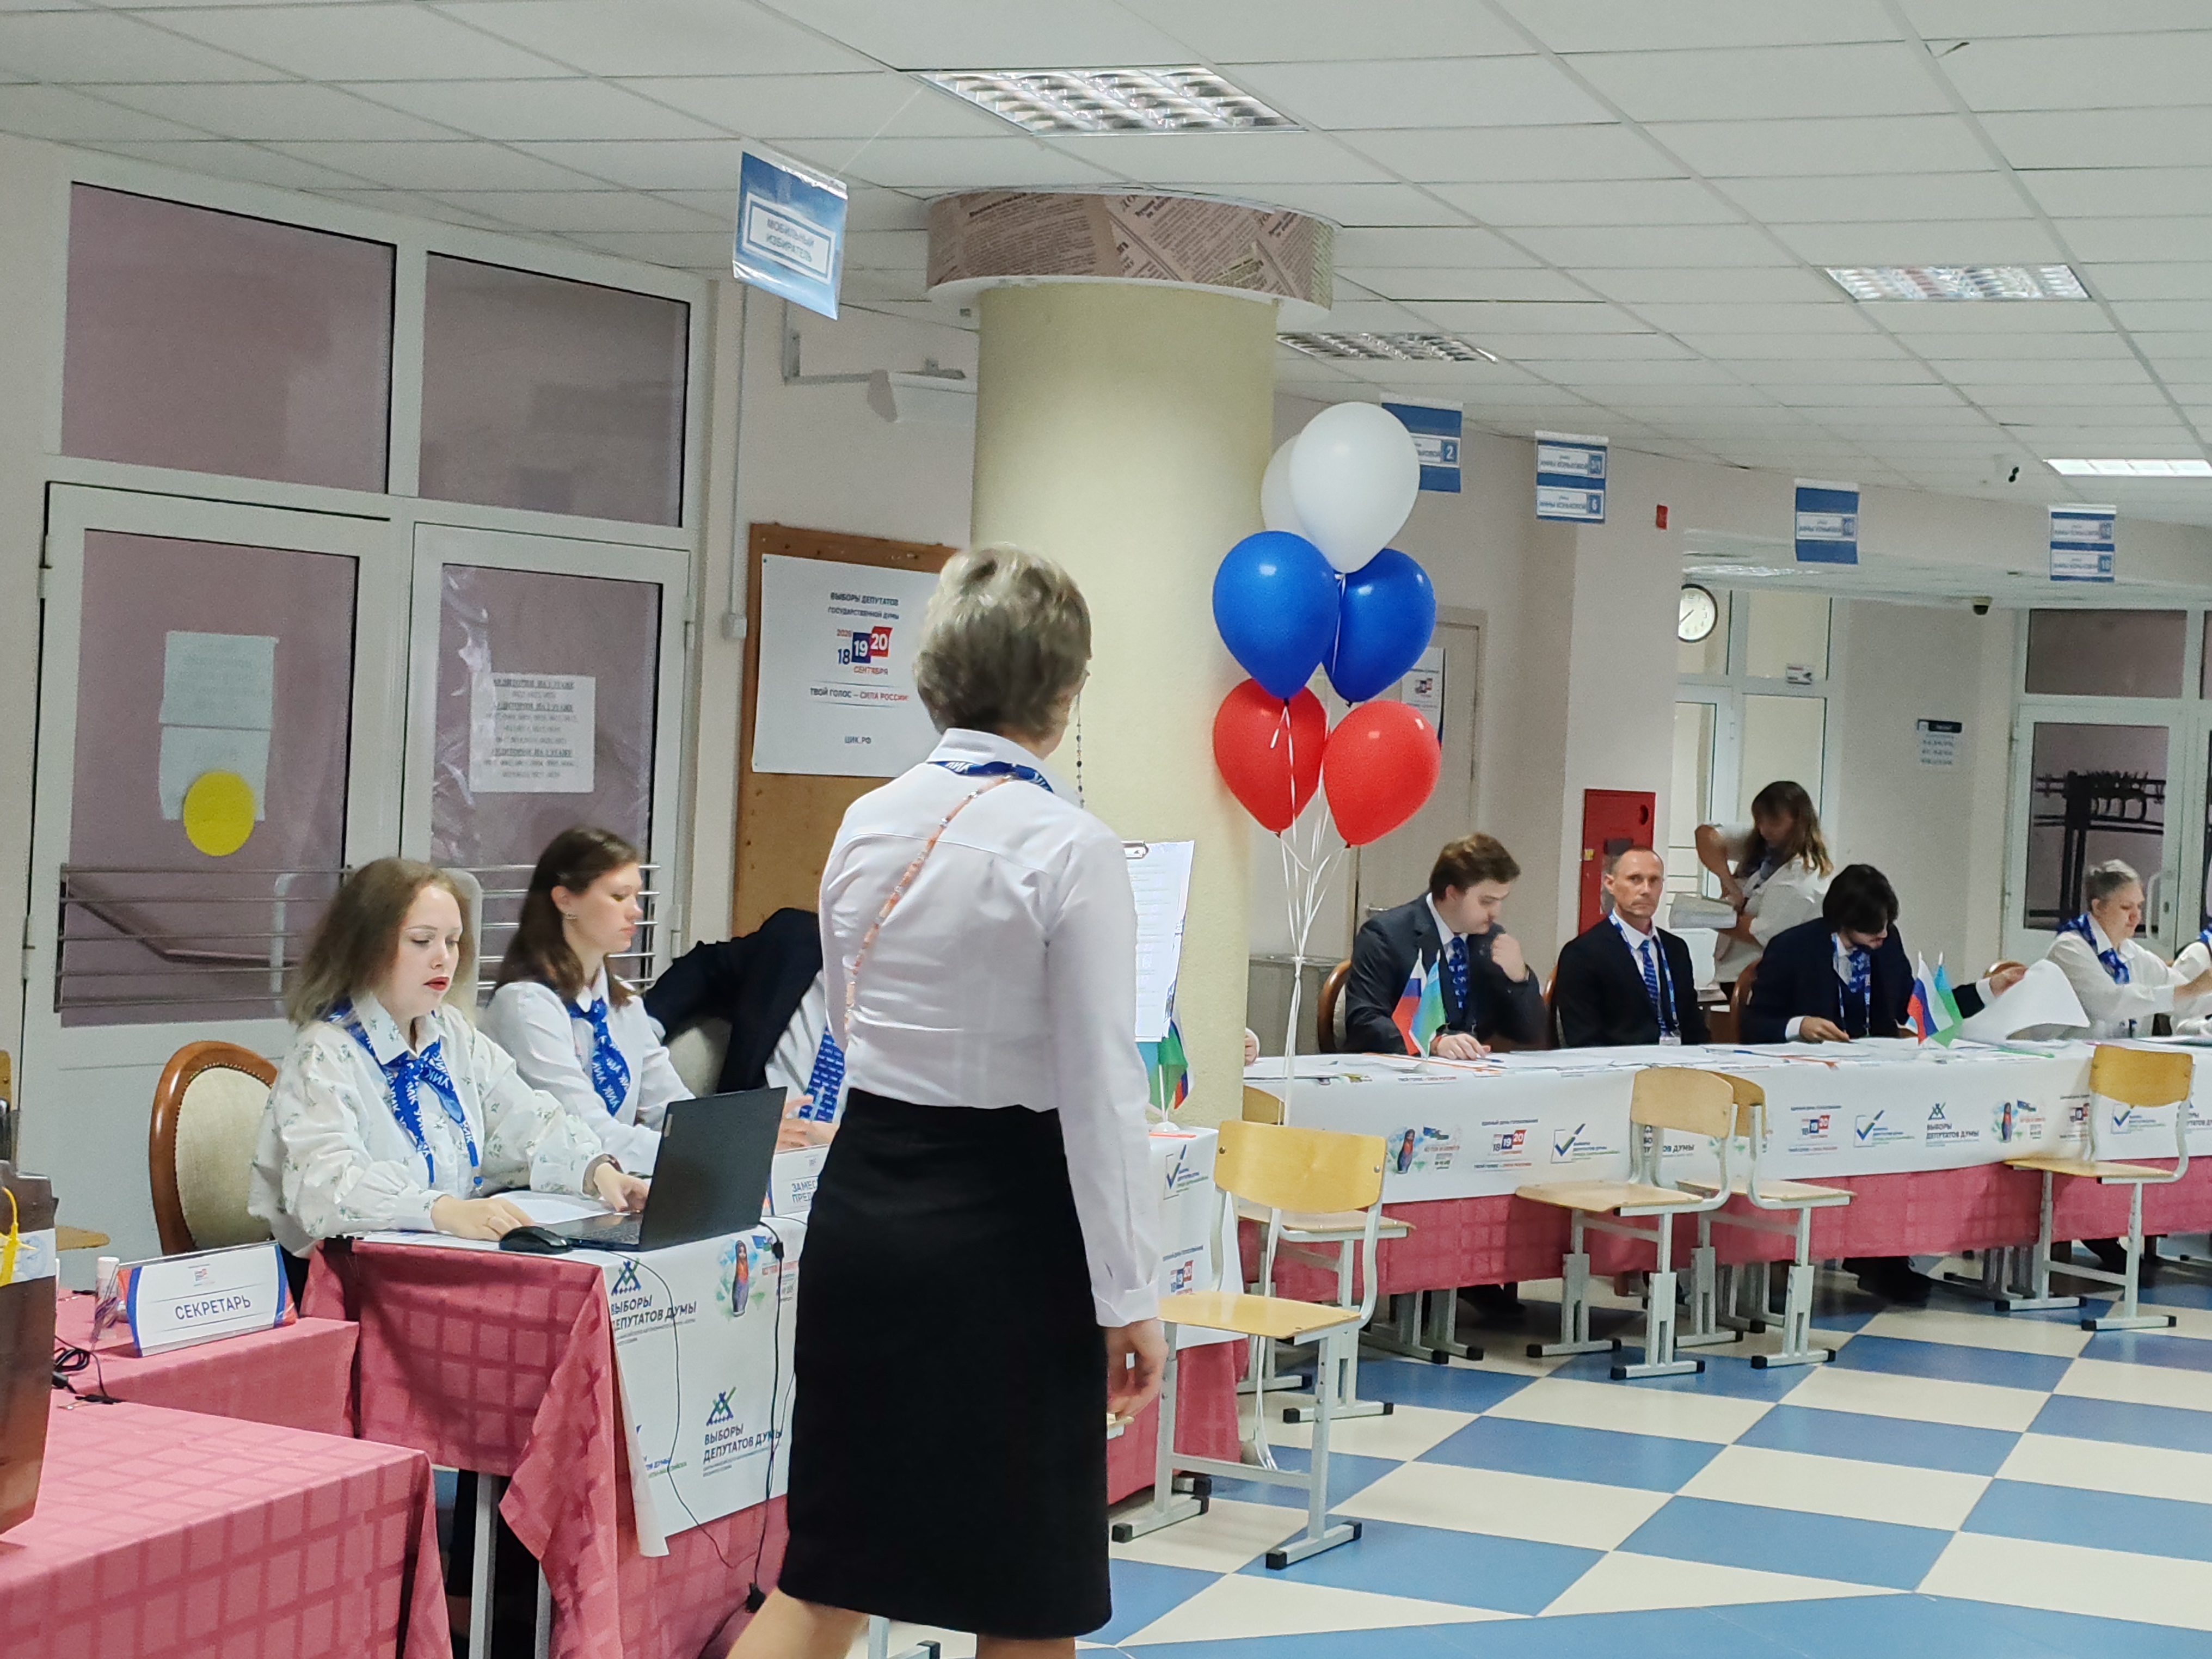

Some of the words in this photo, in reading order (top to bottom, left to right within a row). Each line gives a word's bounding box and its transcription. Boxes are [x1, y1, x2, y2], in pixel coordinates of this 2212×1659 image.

[1446, 445, 1454, 459] 2
[831, 592, 860, 603] ВЫБОРЫ
[861, 595, 899, 606] ДЕПУТАТОВ
[828, 606, 882, 618] ГОСУДАРСТВЕННОЙ
[838, 648, 850, 665] 18
[854, 640, 868, 657] 19
[871, 633, 888, 650] 20
[853, 666, 888, 675] СЕНТЯБРЯ
[810, 687, 828, 697] ТВОЙ
[830, 689, 852, 698] ГОЛОС
[860, 691, 878, 700] СИЛА
[880, 693, 909, 701] РОССИИ
[424, 1069, 450, 1089] УИК
[602, 1084, 620, 1108] УИК
[1493, 1144, 1501, 1152] 18
[1503, 1138, 1512, 1147] 19
[1514, 1133, 1523, 1142] 20
[1926, 1131, 1959, 1140] ДЕПУТАТОВ
[1961, 1130, 1980, 1139] ДУМЫ
[1672, 1145, 1695, 1153] ДУМЫ
[175, 1295, 251, 1320] СЕКРЕТАРЬ
[613, 1309, 663, 1332] ЕПУТАТОВ
[665, 1301, 697, 1322] ДУМЫ
[705, 1423, 744, 1446] ВЫБОРЫ
[703, 1436, 754, 1464] ДЕПУТАТОВ
